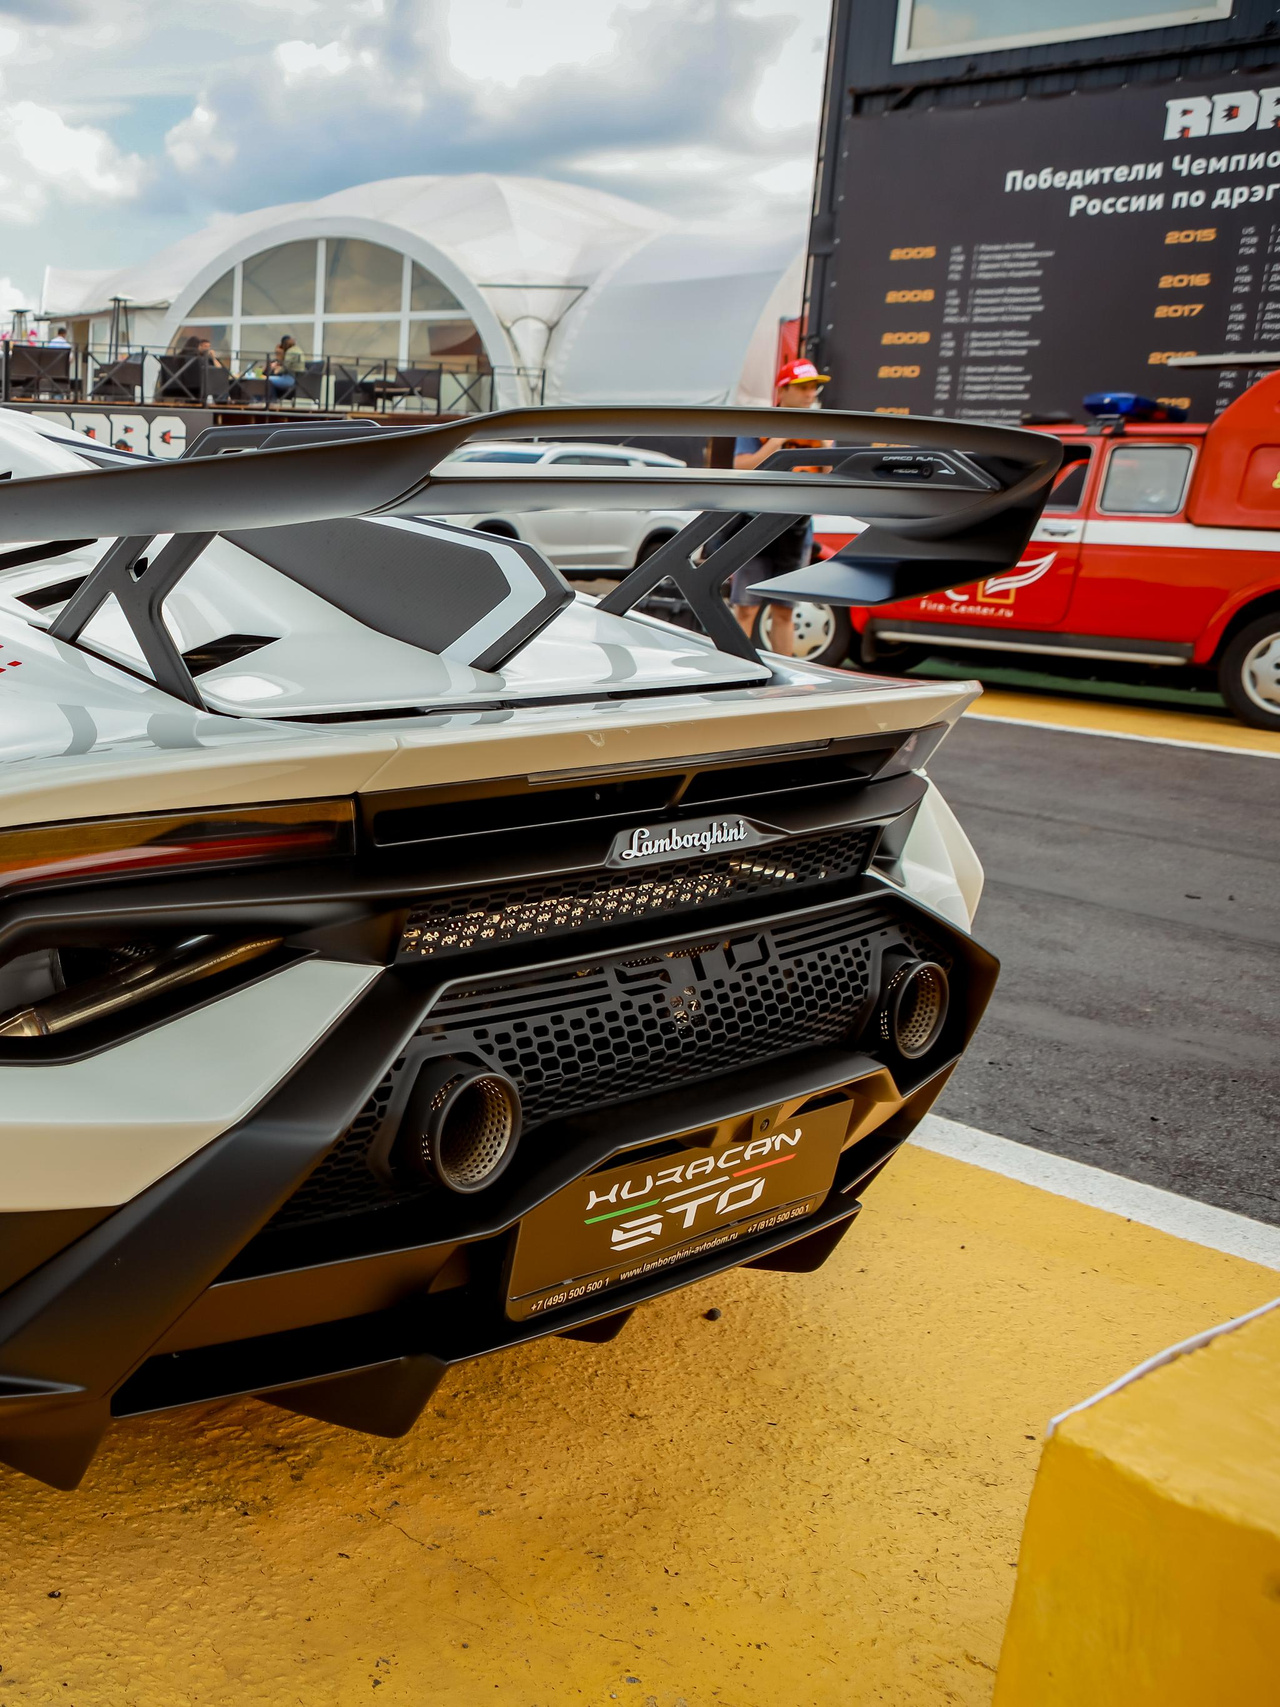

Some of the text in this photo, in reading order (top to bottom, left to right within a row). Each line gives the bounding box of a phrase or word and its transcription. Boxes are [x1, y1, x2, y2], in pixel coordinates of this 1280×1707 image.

[1004, 150, 1280, 193] Победители Чемпио
[1069, 183, 1280, 217] России по дрэг
[1164, 228, 1217, 245] 2015
[1158, 273, 1211, 288] 2016
[1154, 304, 1205, 318] 2017
[31, 411, 186, 458] DRC
[920, 599, 1014, 618] Fire-Center.ru
[622, 820, 748, 859] Lamborghini
[613, 932, 770, 997] STO
[610, 1176, 766, 1251] STO
[543, 1293, 568, 1310] (495)
[568, 1286, 586, 1300] 500
[586, 1280, 603, 1293] 500
[620, 1232, 739, 1280] www.lamborghini-avtodom.ru
[757, 1216, 776, 1232] (812)
